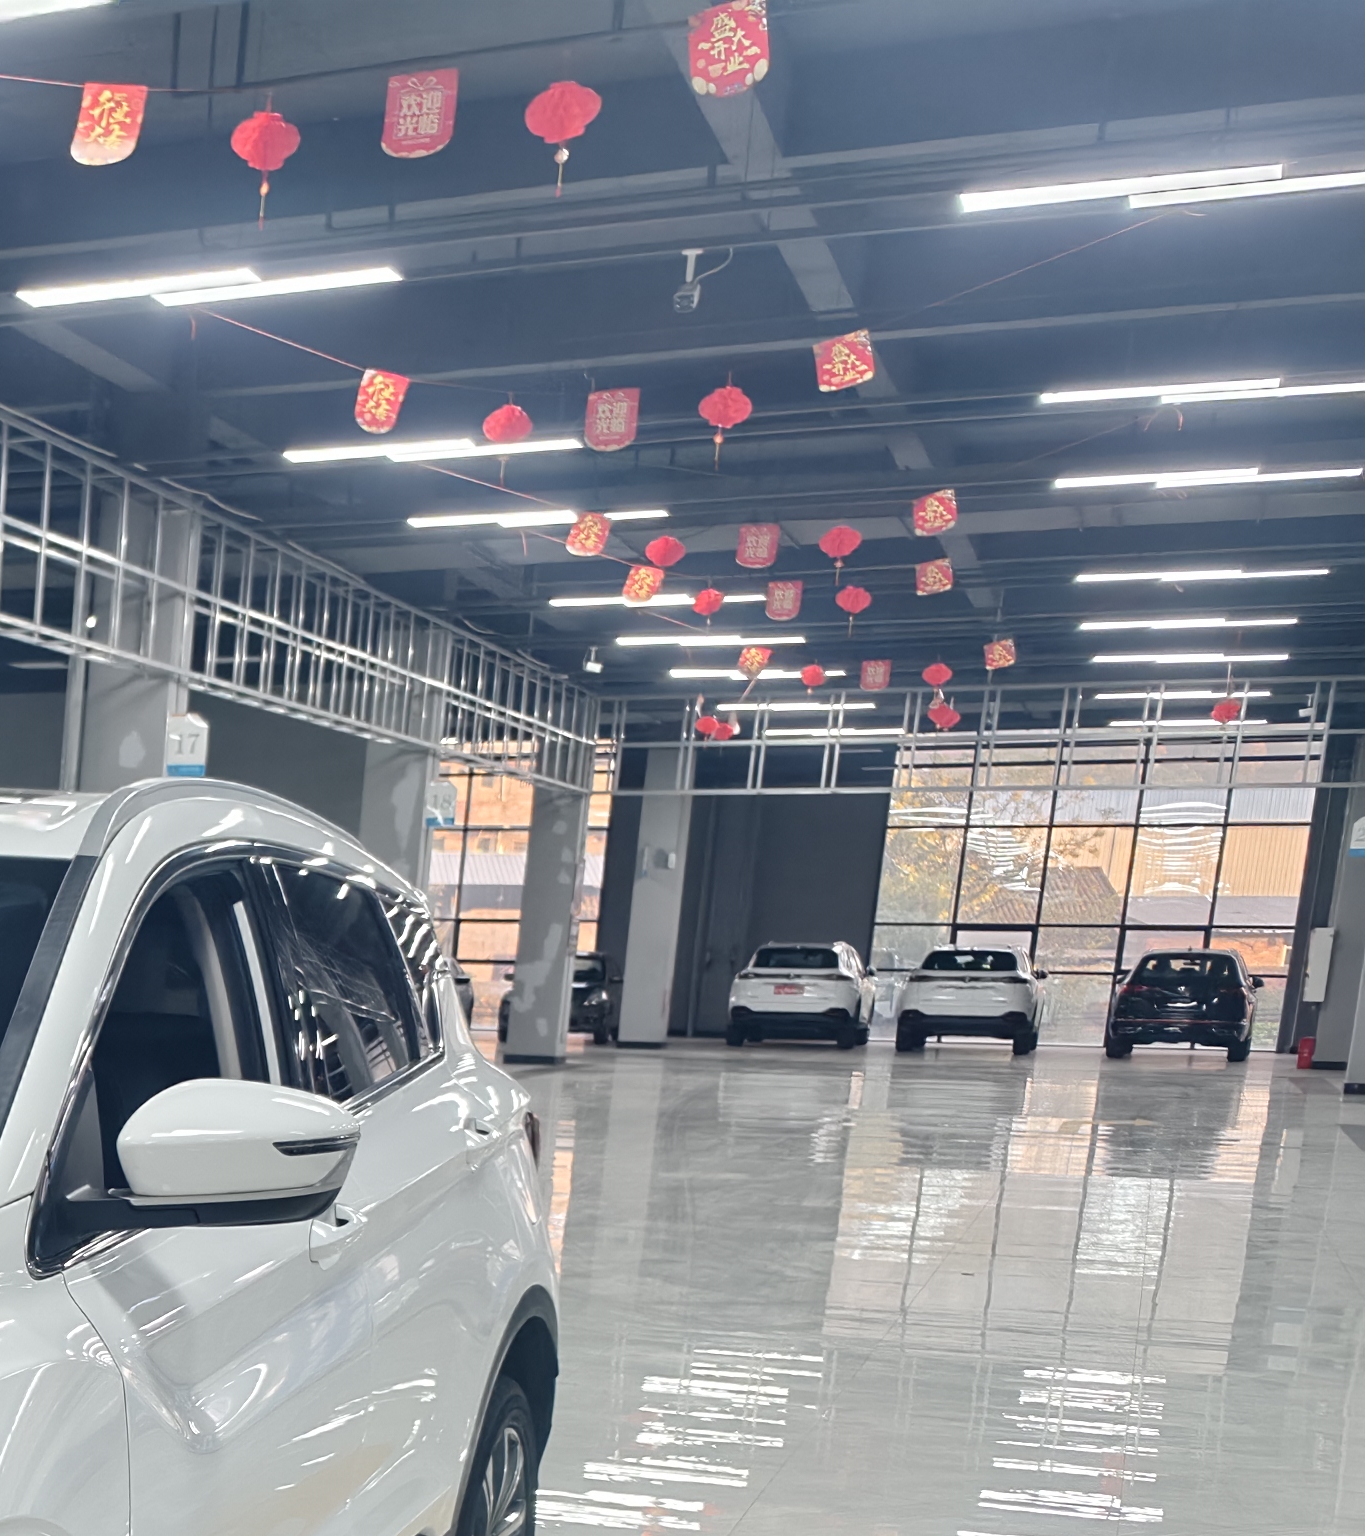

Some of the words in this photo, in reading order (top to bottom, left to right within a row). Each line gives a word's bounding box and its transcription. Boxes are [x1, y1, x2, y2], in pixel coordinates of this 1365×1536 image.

[399, 91, 442, 117] 欢迎
[396, 113, 439, 137] 光临
[174, 733, 200, 756] 17
